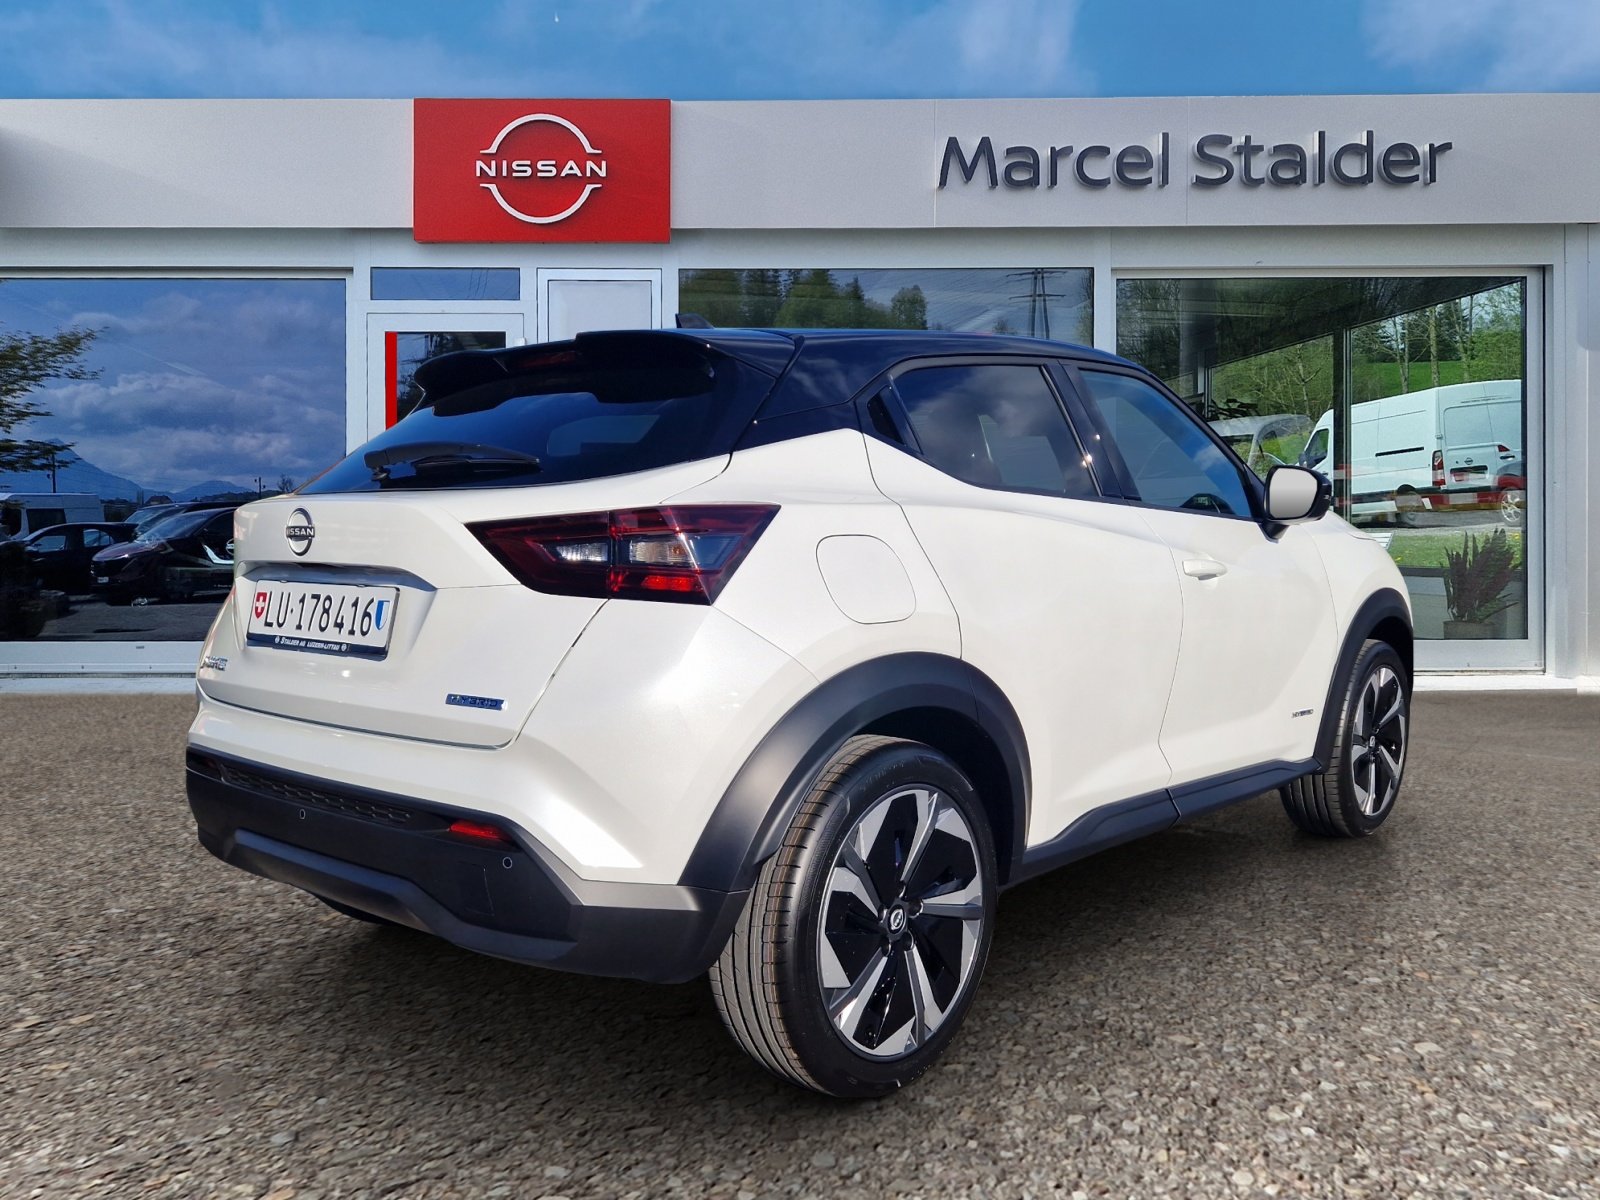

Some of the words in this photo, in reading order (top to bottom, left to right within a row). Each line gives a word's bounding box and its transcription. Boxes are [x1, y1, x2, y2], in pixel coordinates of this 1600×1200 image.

[475, 159, 607, 178] NISSAN
[937, 132, 1170, 189] Marcel
[1191, 130, 1453, 186] Stalder
